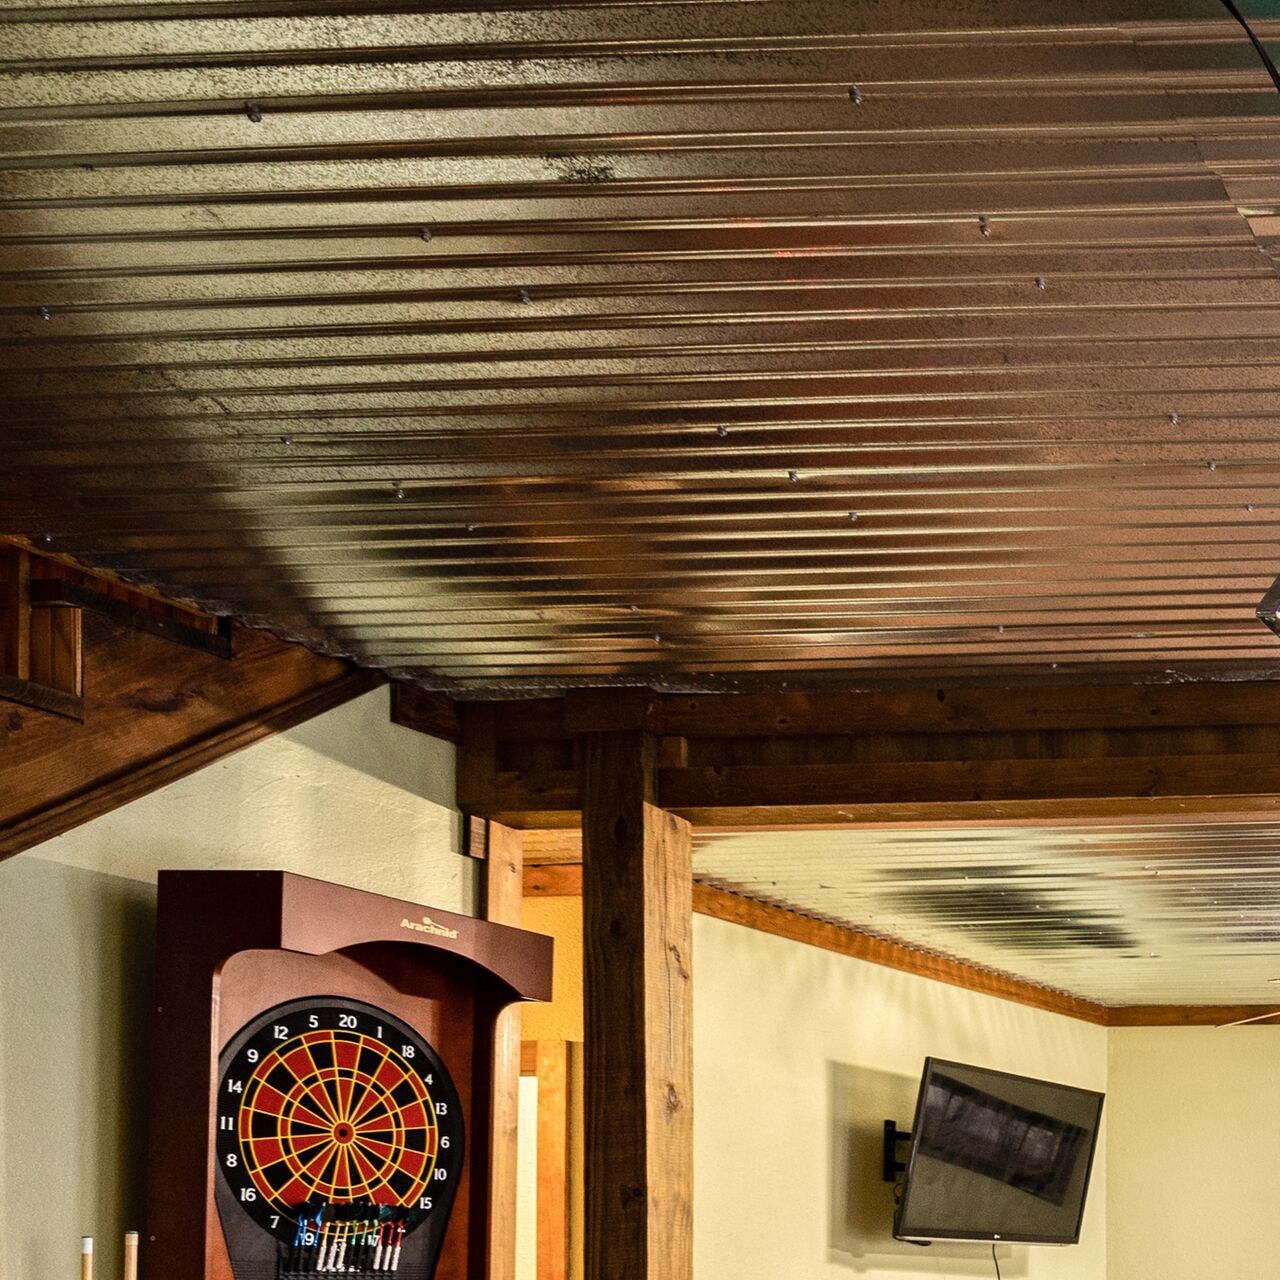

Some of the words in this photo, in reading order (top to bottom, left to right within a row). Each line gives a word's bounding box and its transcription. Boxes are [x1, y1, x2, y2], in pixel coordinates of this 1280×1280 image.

[400, 918, 459, 939] Arachnid
[308, 1014, 319, 1028] 5
[338, 1014, 357, 1028] 20
[273, 1025, 288, 1040] 12
[377, 1026, 382, 1039] 1
[246, 1049, 259, 1063] 9
[401, 1045, 415, 1058] 18
[227, 1078, 243, 1093] 14
[424, 1074, 433, 1085] 4
[435, 1102, 448, 1115] 13
[220, 1116, 234, 1131] 11
[440, 1136, 450, 1148] 6
[226, 1153, 238, 1167] 8
[434, 1168, 447, 1180] 10
[240, 1188, 256, 1201] 16
[420, 1197, 432, 1210] 15
[269, 1215, 280, 1229] 7
